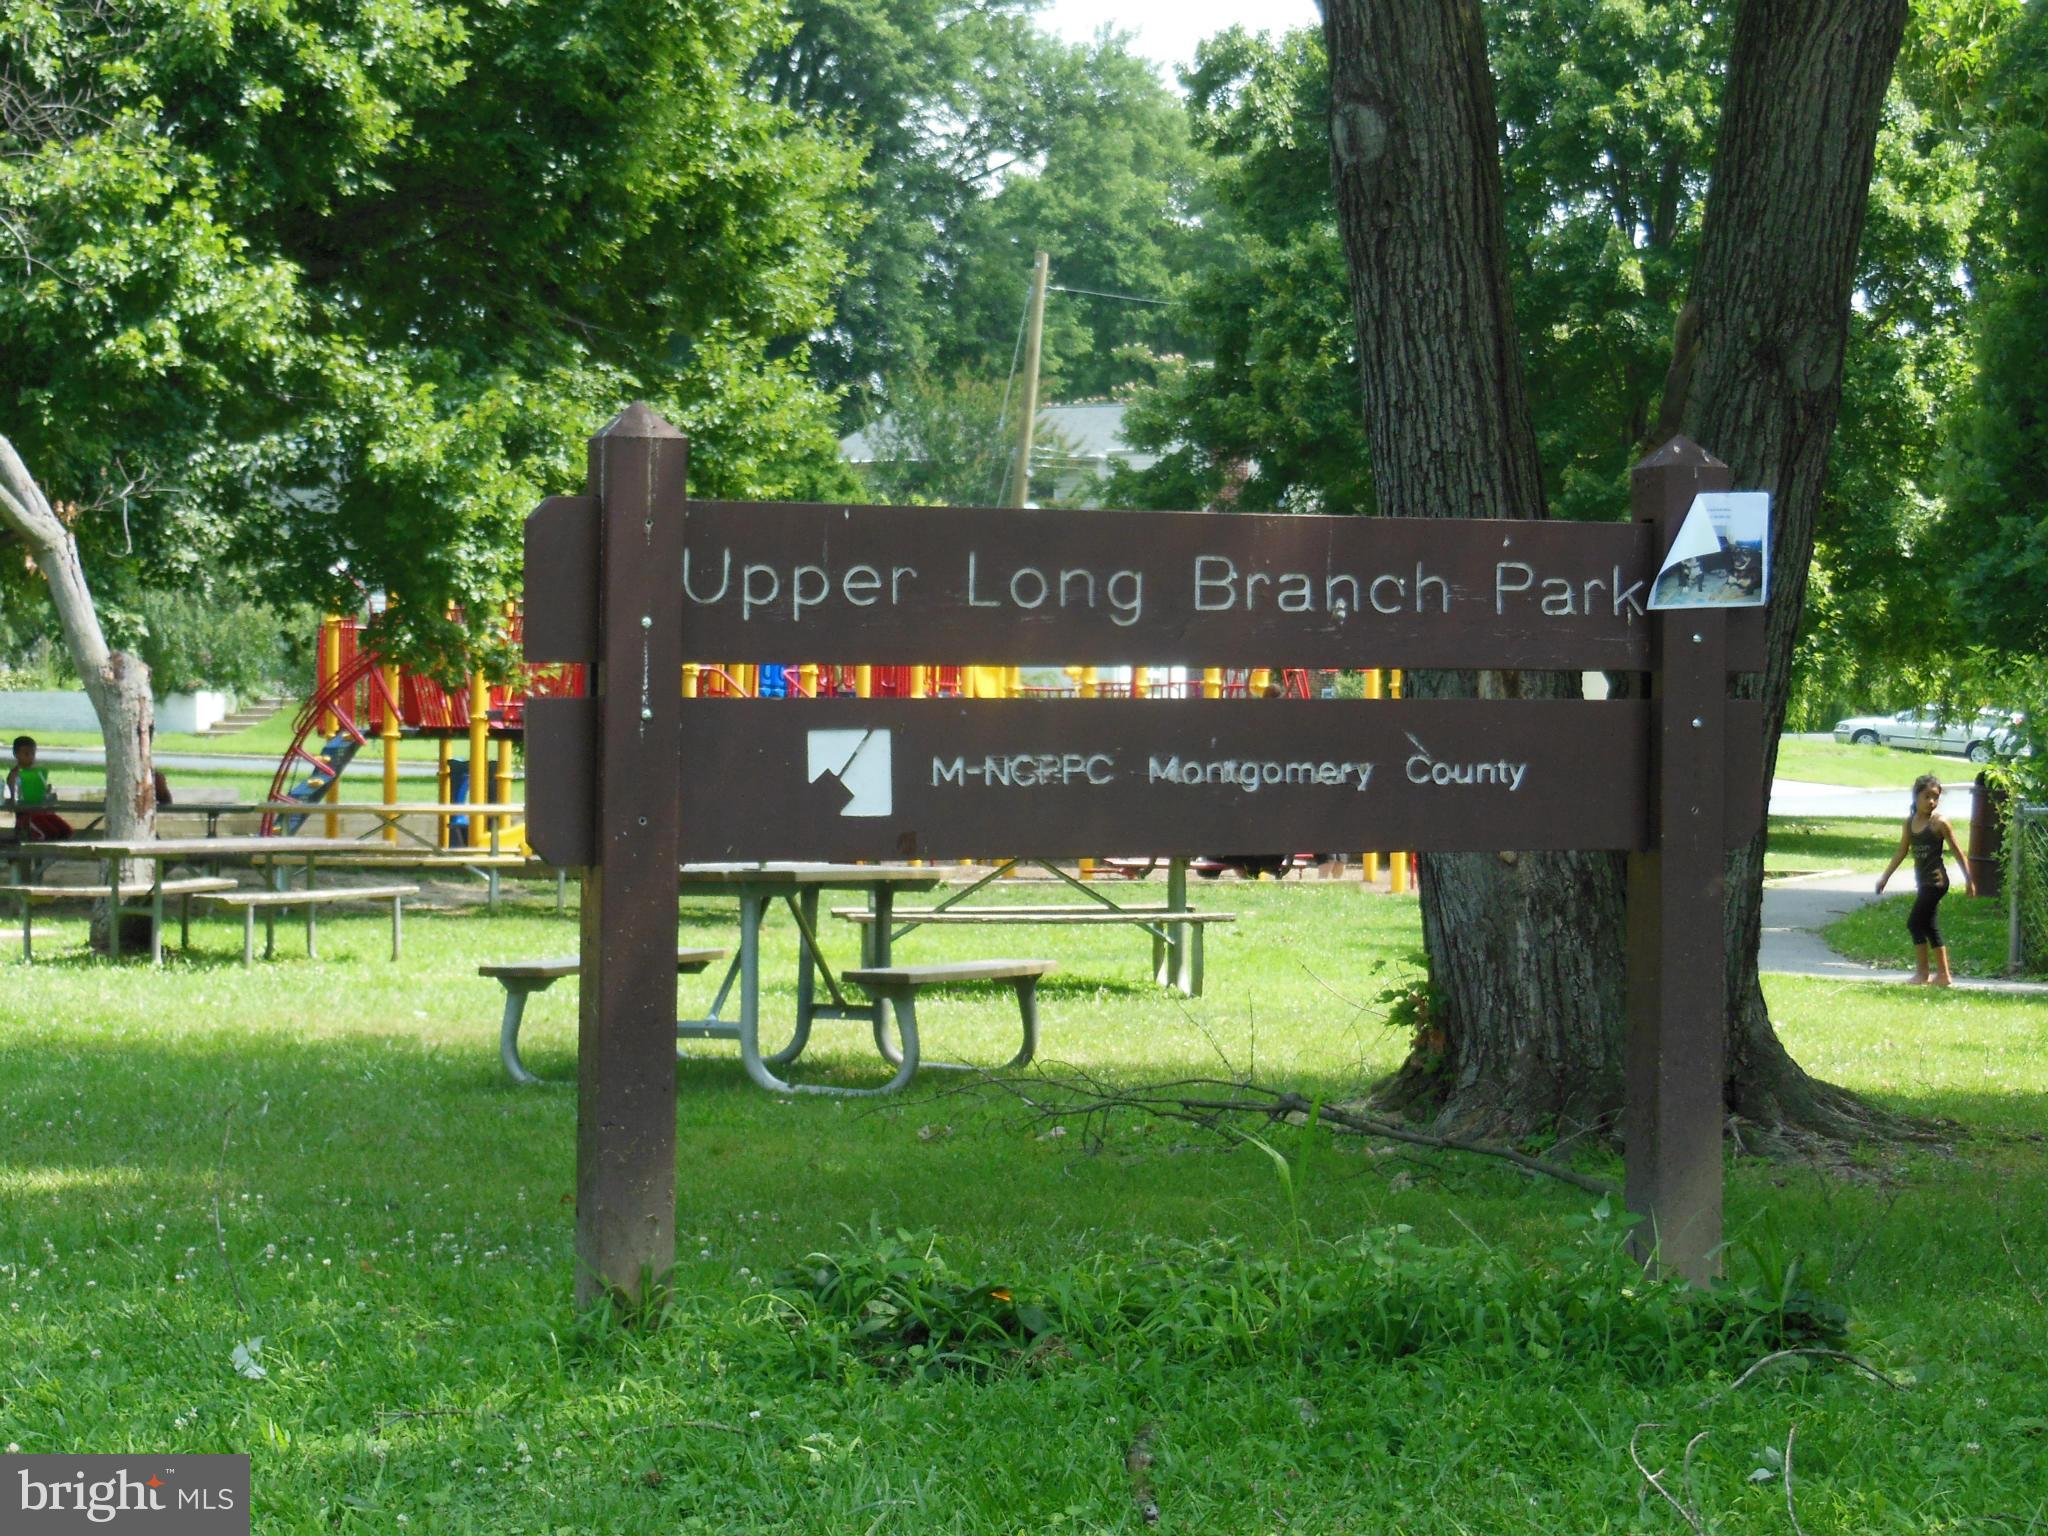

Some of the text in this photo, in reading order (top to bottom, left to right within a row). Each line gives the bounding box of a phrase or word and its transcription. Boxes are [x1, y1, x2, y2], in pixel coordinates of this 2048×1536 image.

[683, 547, 1645, 627] Upper Long Branch Park
[1148, 754, 1375, 792] Montgomery
[1405, 754, 1527, 792] County
